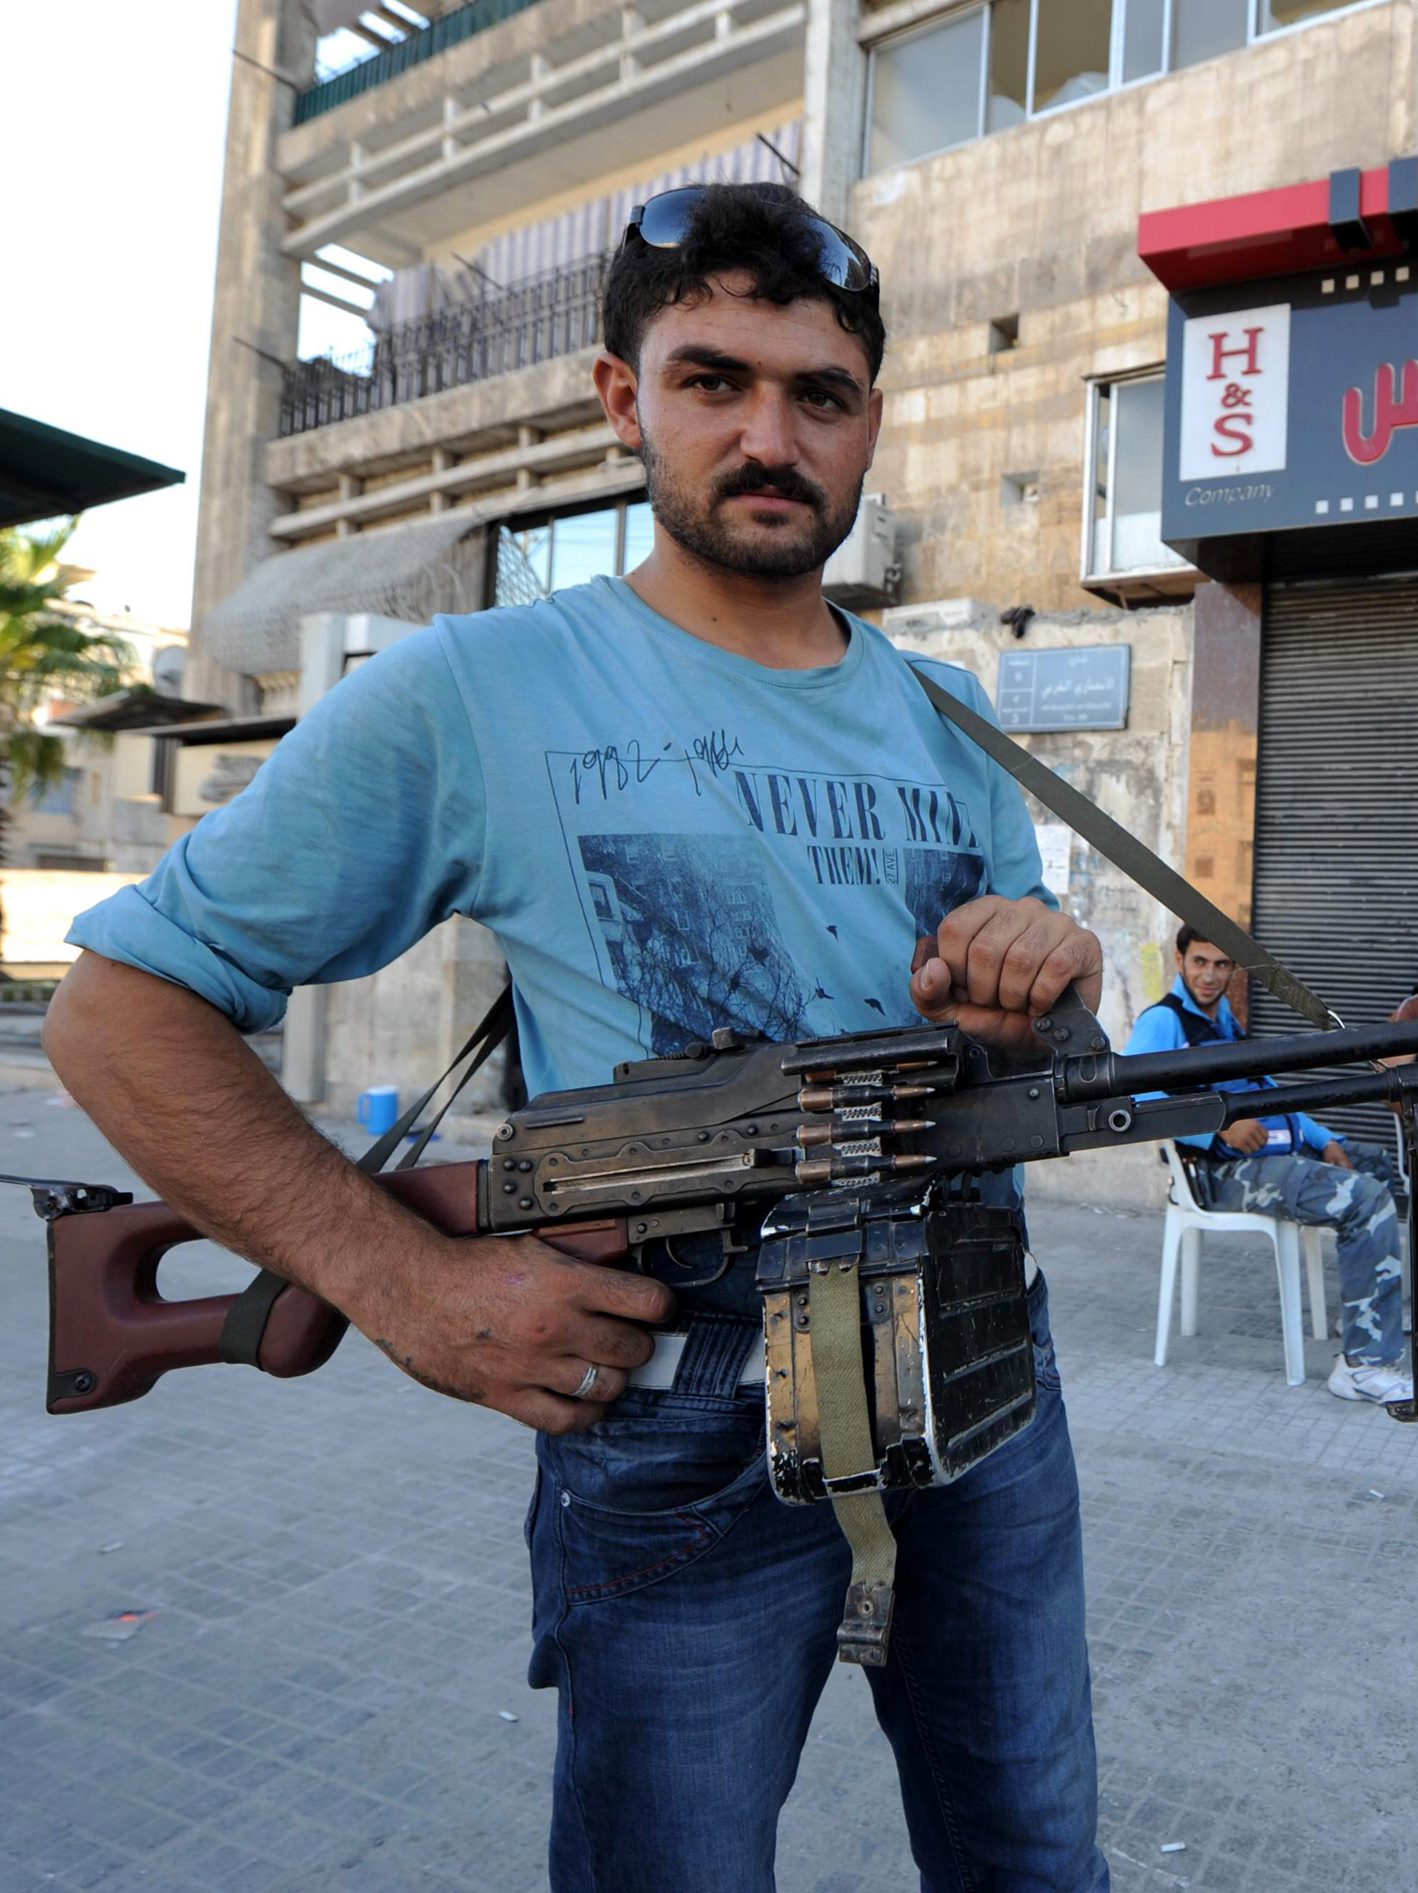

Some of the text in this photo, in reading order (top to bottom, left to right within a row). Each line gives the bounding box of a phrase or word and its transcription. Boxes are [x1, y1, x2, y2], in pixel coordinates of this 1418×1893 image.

[1206, 327, 1265, 381] H
[1221, 382, 1253, 409] &
[1210, 412, 1254, 457] S
[1184, 483, 1274, 507] Company
[732, 770, 886, 841] NEVER
[806, 845, 882, 885] THEM!
